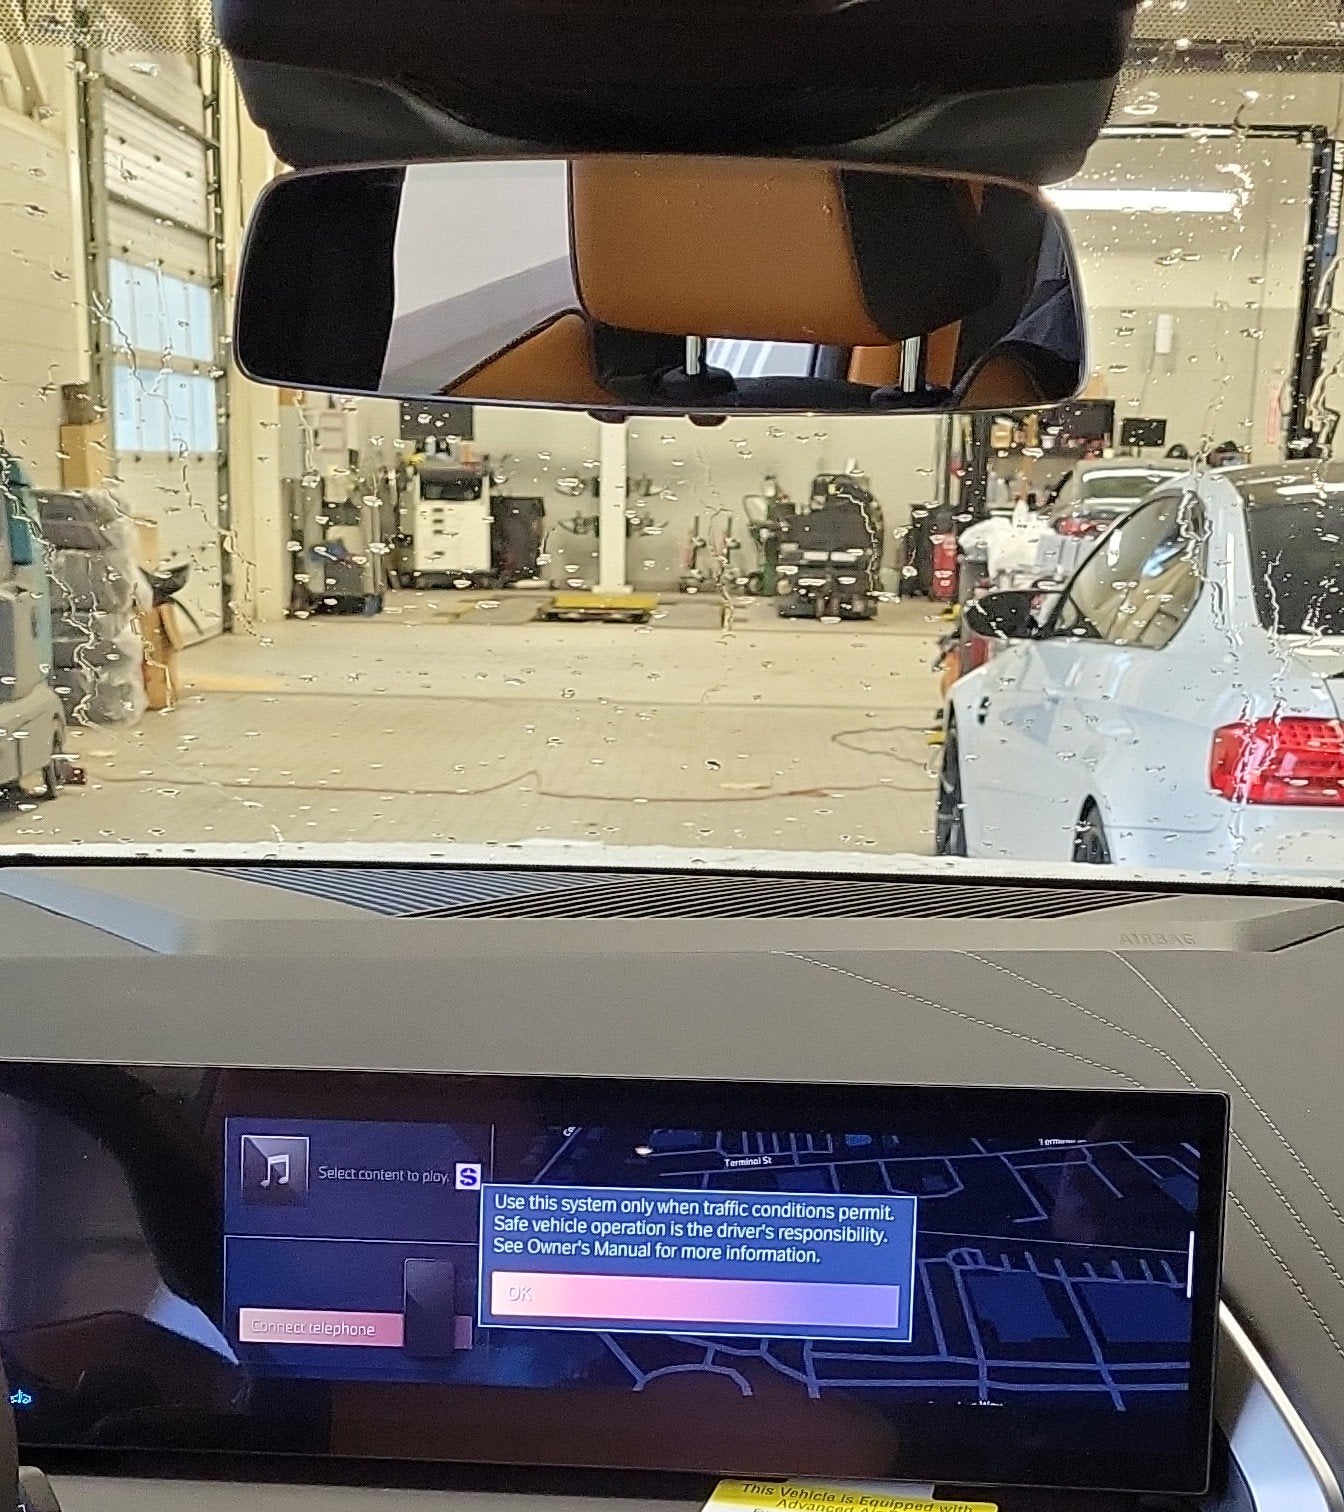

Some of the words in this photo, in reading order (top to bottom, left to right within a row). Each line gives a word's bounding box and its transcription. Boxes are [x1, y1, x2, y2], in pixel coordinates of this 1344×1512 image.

[318, 1166, 356, 1180] Select
[358, 1168, 404, 1181] content
[407, 1170, 419, 1181] to
[724, 1157, 762, 1168] Terminal
[494, 1193, 526, 1210] Use
[528, 1194, 558, 1211] this
[561, 1198, 617, 1214] system
[620, 1198, 654, 1216] only
[656, 1199, 700, 1216] when
[703, 1200, 748, 1217] traffic
[752, 1202, 836, 1220] conditions
[838, 1204, 895, 1222] permit.
[494, 1216, 528, 1232] Safe
[532, 1217, 587, 1234] vehicle
[590, 1220, 666, 1237] operation
[670, 1220, 684, 1237] is
[686, 1222, 713, 1238] the
[716, 1222, 774, 1240] driver's
[778, 1226, 888, 1246] responsibility.
[493, 1237, 524, 1254] See
[527, 1238, 591, 1256] Owner's
[594, 1240, 651, 1258] Manual
[655, 1242, 678, 1259] for
[680, 1245, 722, 1260] more
[726, 1244, 820, 1263] information.
[508, 1285, 534, 1303] OK
[252, 1320, 306, 1334] Connect
[309, 1322, 376, 1338] telephone
[742, 1484, 775, 1496] This
[780, 1487, 836, 1502] Vehicle
[860, 1496, 934, 1512] Equipped
